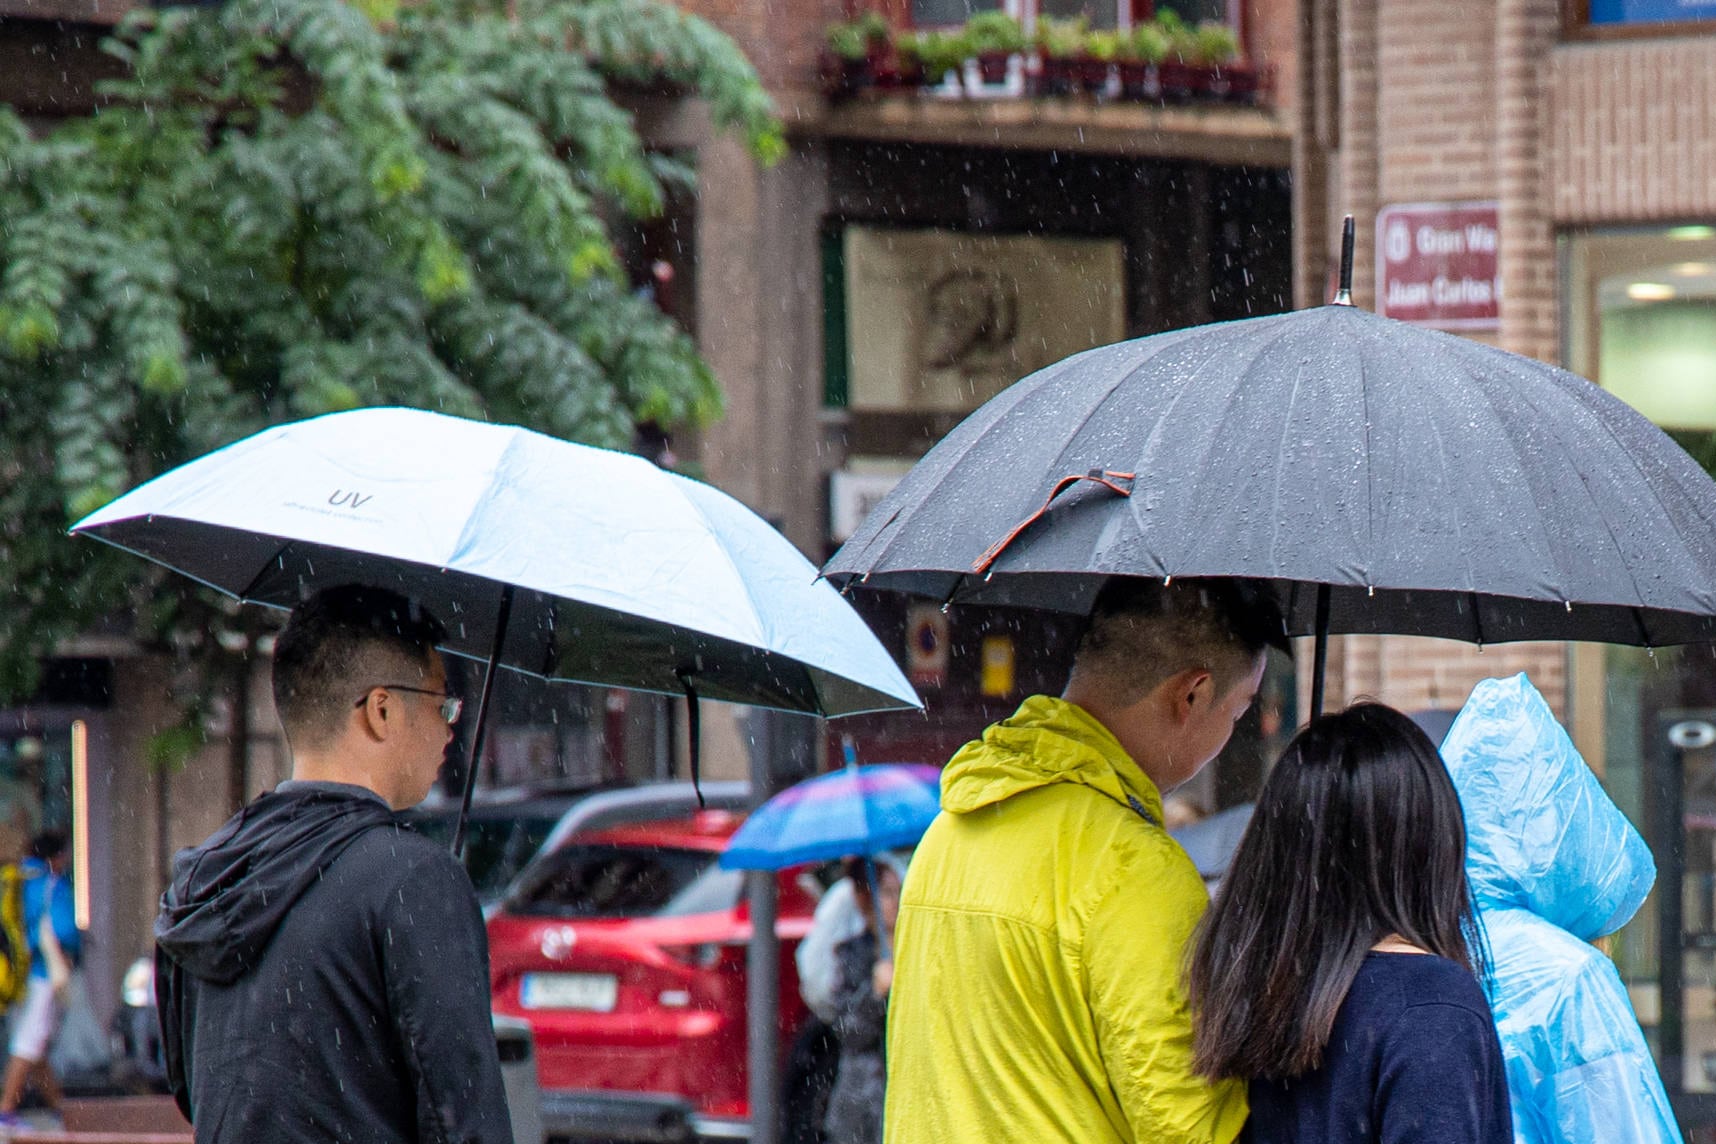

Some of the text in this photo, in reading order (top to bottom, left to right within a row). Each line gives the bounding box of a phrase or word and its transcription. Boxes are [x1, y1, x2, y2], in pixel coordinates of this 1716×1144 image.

[1416, 226, 1465, 254] Gran
[1433, 276, 1490, 305] Carlos
[328, 489, 374, 509] UV
